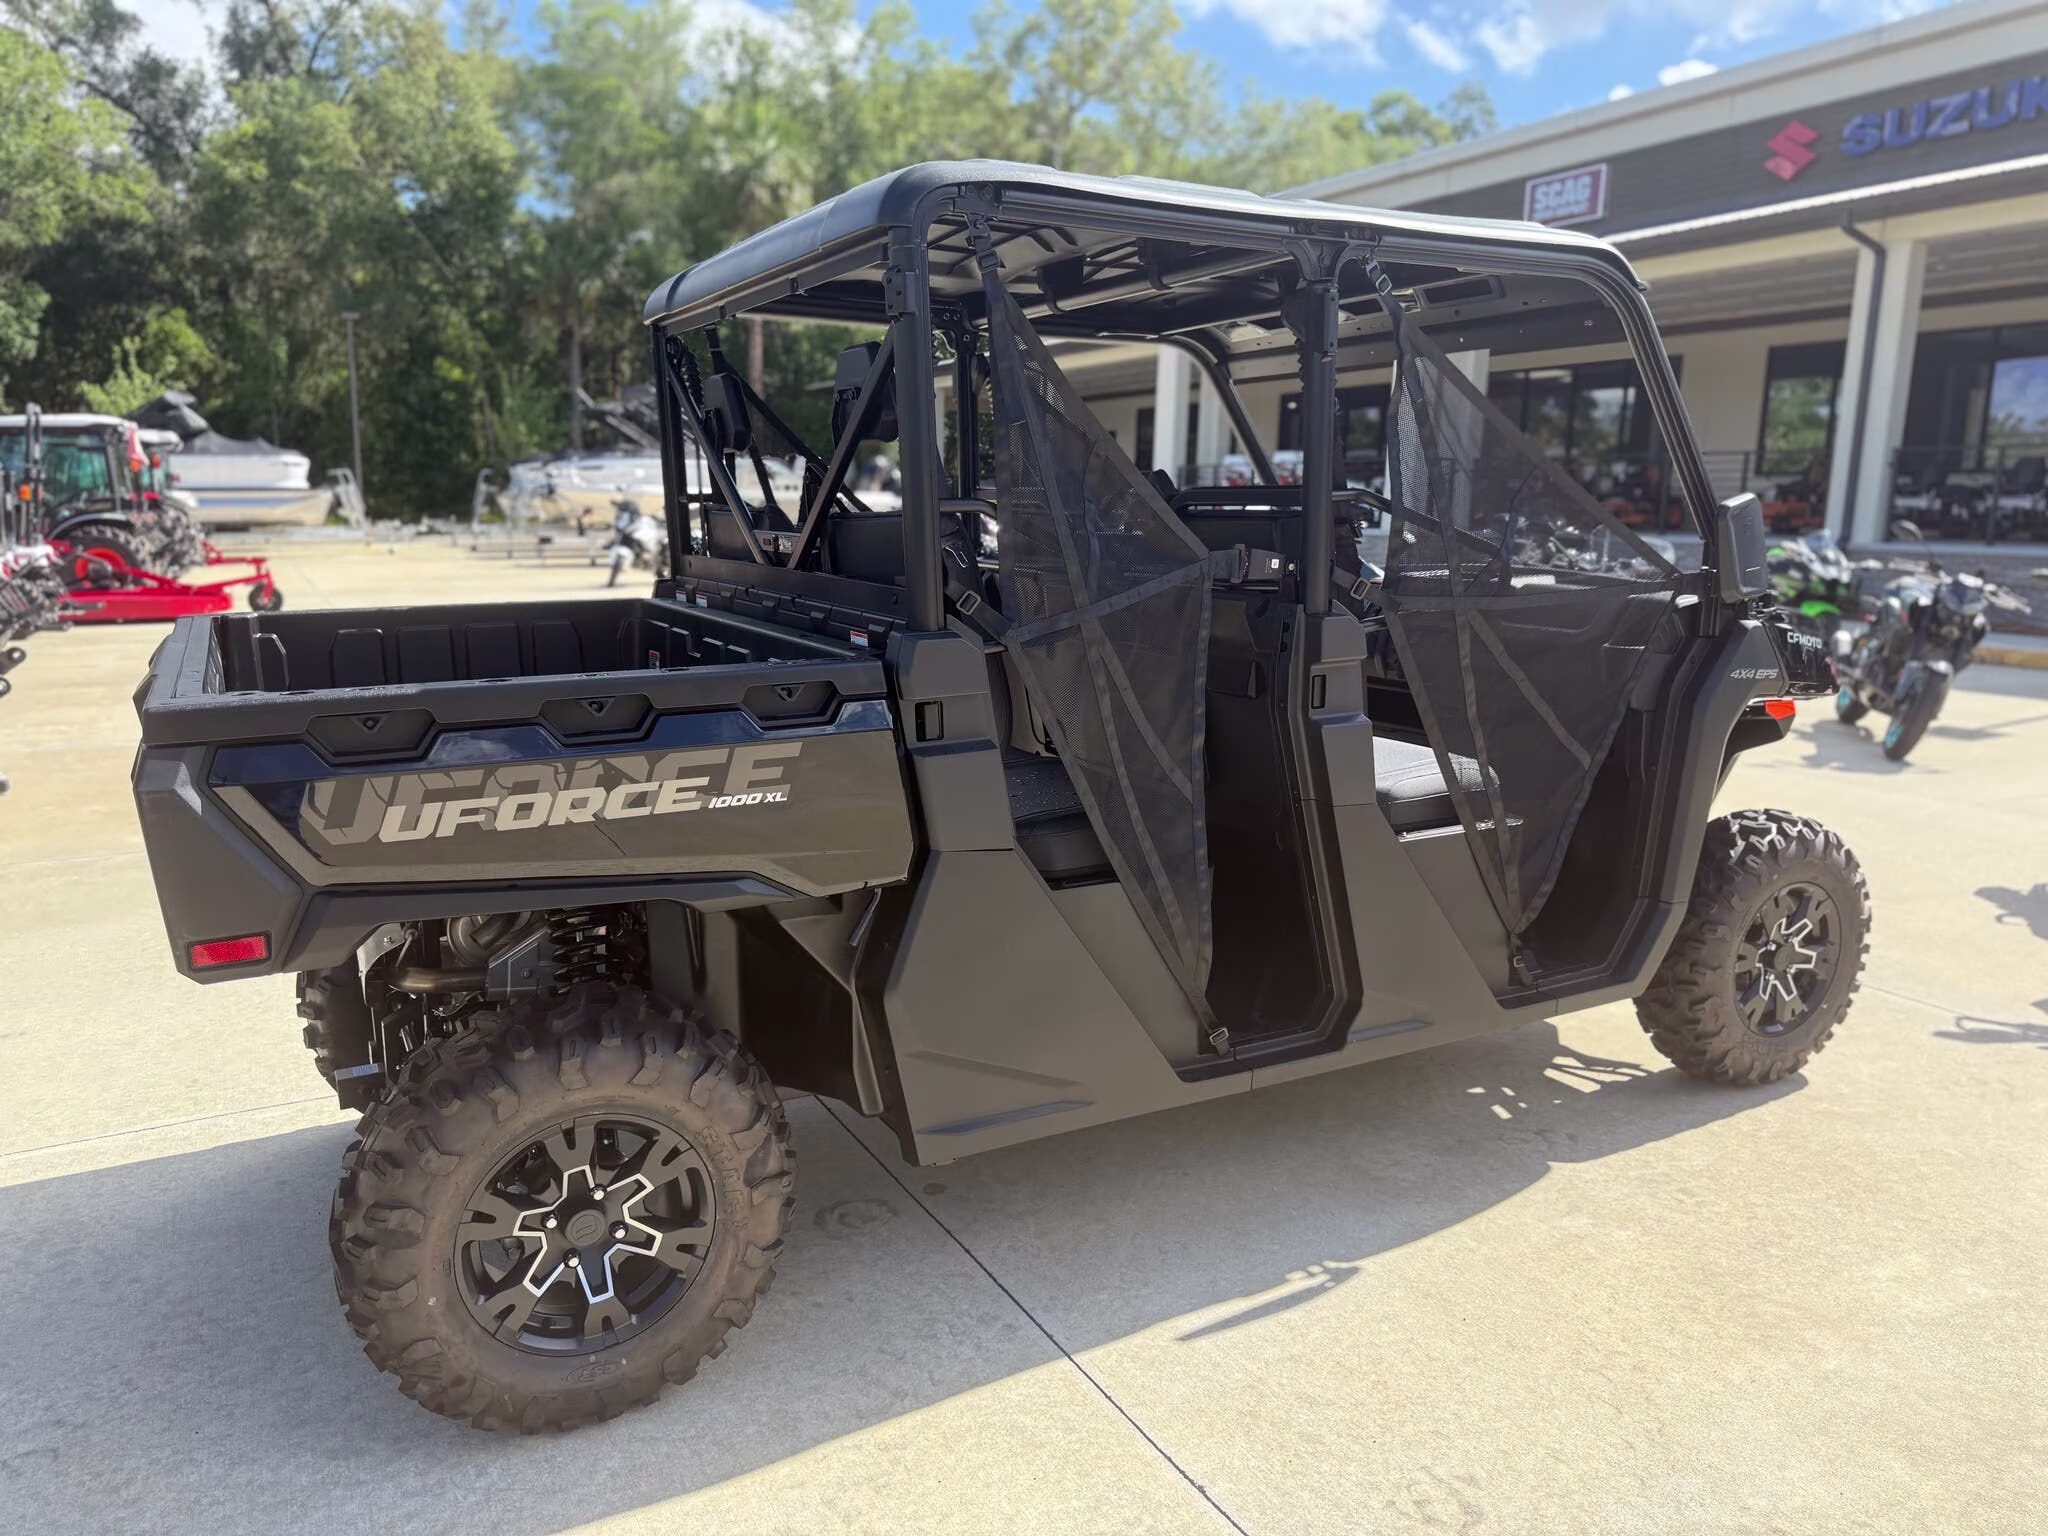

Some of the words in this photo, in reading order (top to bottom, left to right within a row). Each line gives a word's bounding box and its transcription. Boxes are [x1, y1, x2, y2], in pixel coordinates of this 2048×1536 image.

[1787, 631, 1822, 648] CFMOTO
[1730, 669, 1755, 679] 4X4
[1755, 669, 1779, 679] EPS
[378, 776, 710, 843] UFORCE
[708, 792, 763, 809] 1000
[763, 791, 788, 803] XL
